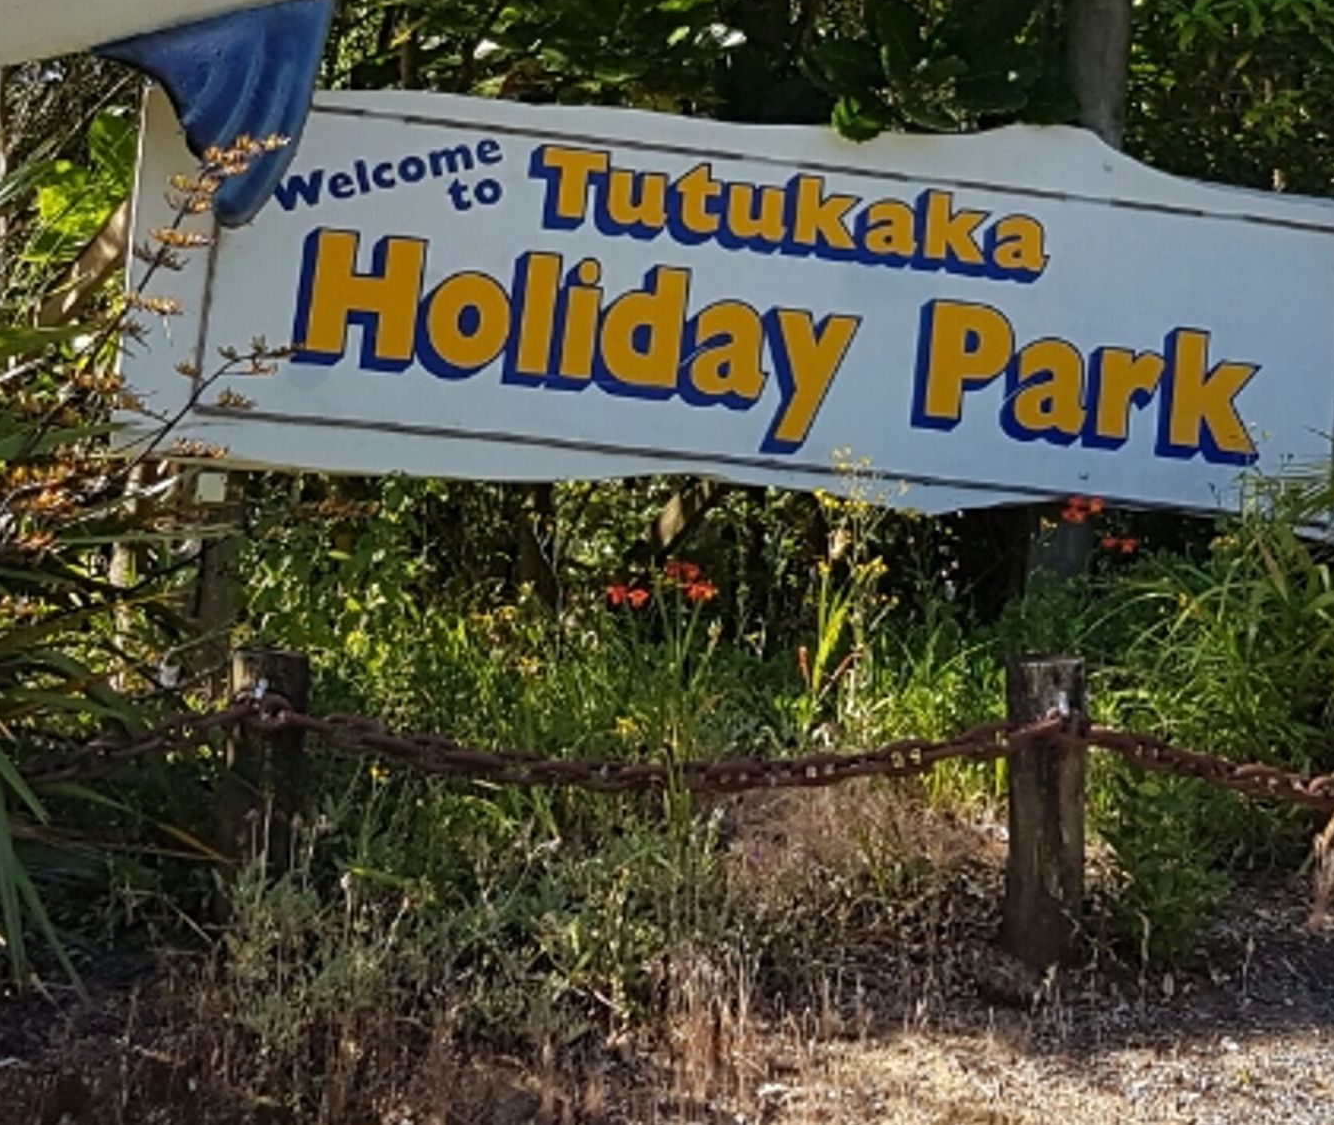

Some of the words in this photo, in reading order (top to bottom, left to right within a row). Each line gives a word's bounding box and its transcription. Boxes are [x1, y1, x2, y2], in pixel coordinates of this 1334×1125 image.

[274, 138, 504, 211] Welcome
[449, 177, 503, 211] to
[529, 145, 1049, 282] Tutukaka
[291, 227, 861, 454] Holiday
[911, 299, 1260, 464] Park
